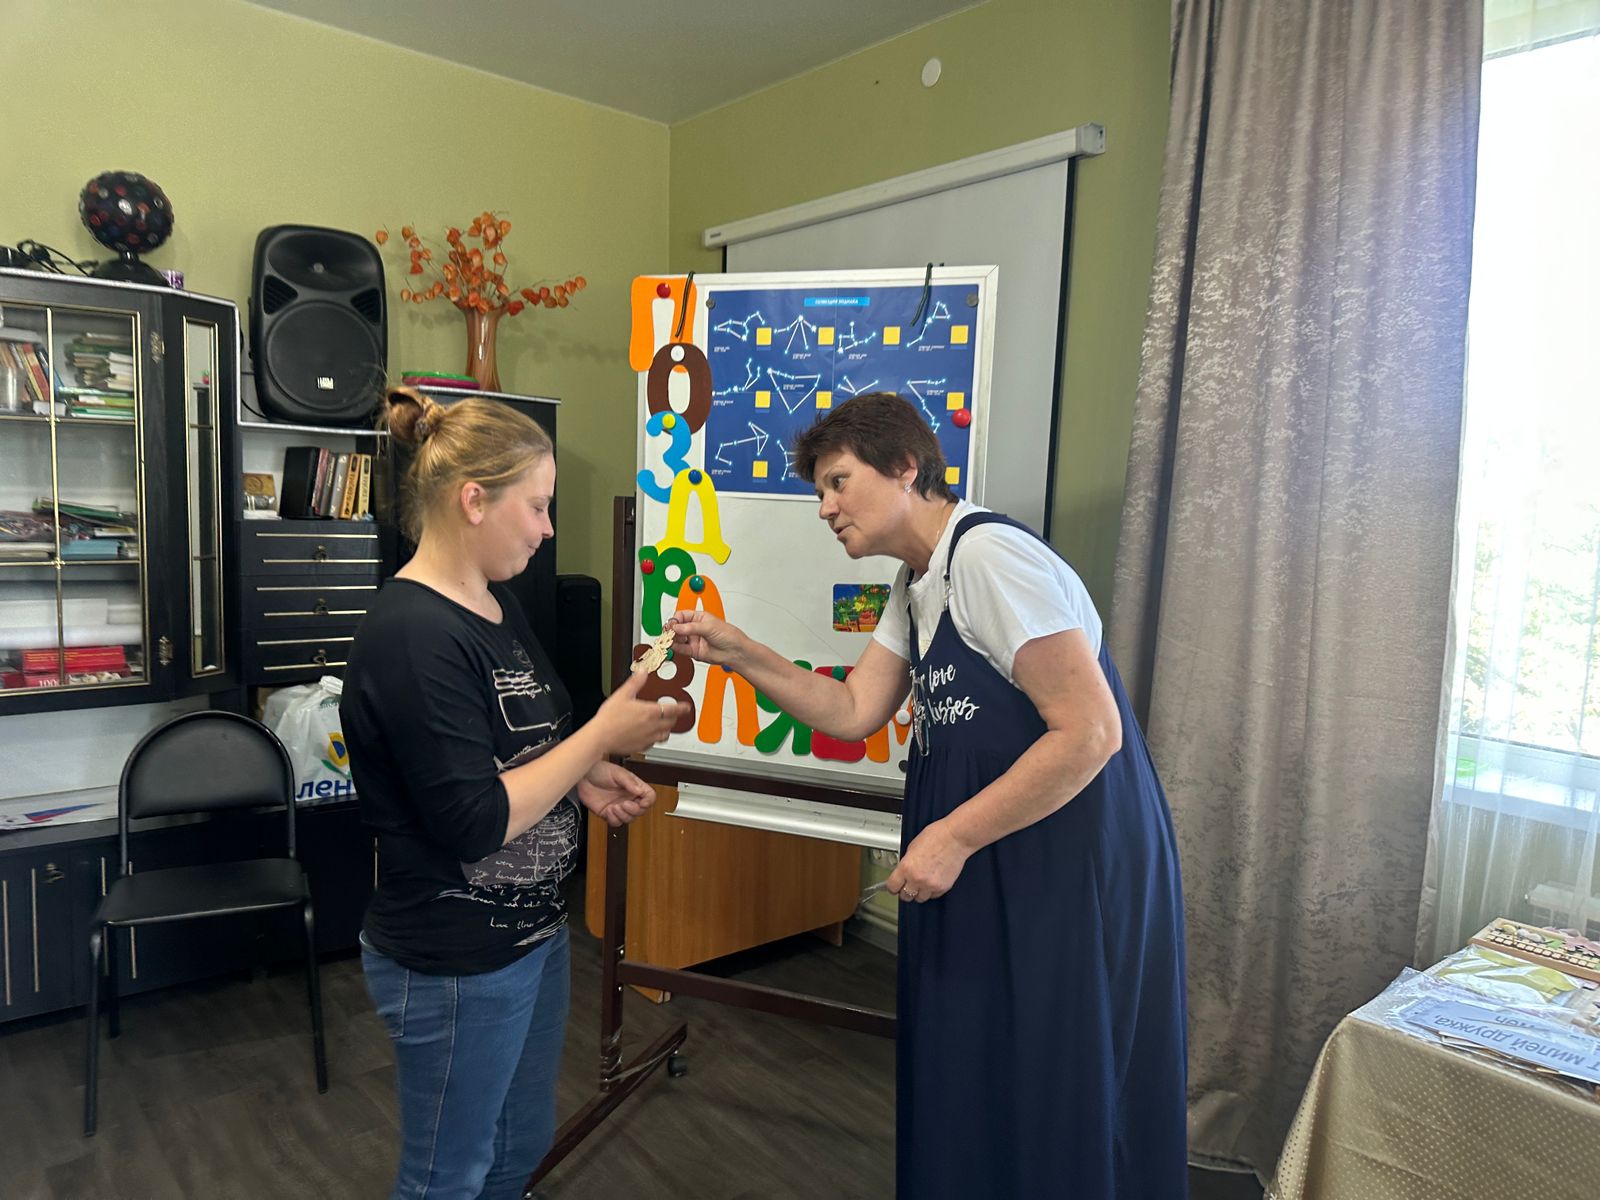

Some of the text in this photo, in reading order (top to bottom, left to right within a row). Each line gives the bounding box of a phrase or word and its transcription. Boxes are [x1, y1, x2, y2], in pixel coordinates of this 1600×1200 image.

[929, 664, 956, 694] love
[1433, 1014, 1512, 1045] дружка,
[1510, 1037, 1585, 1066] милей
